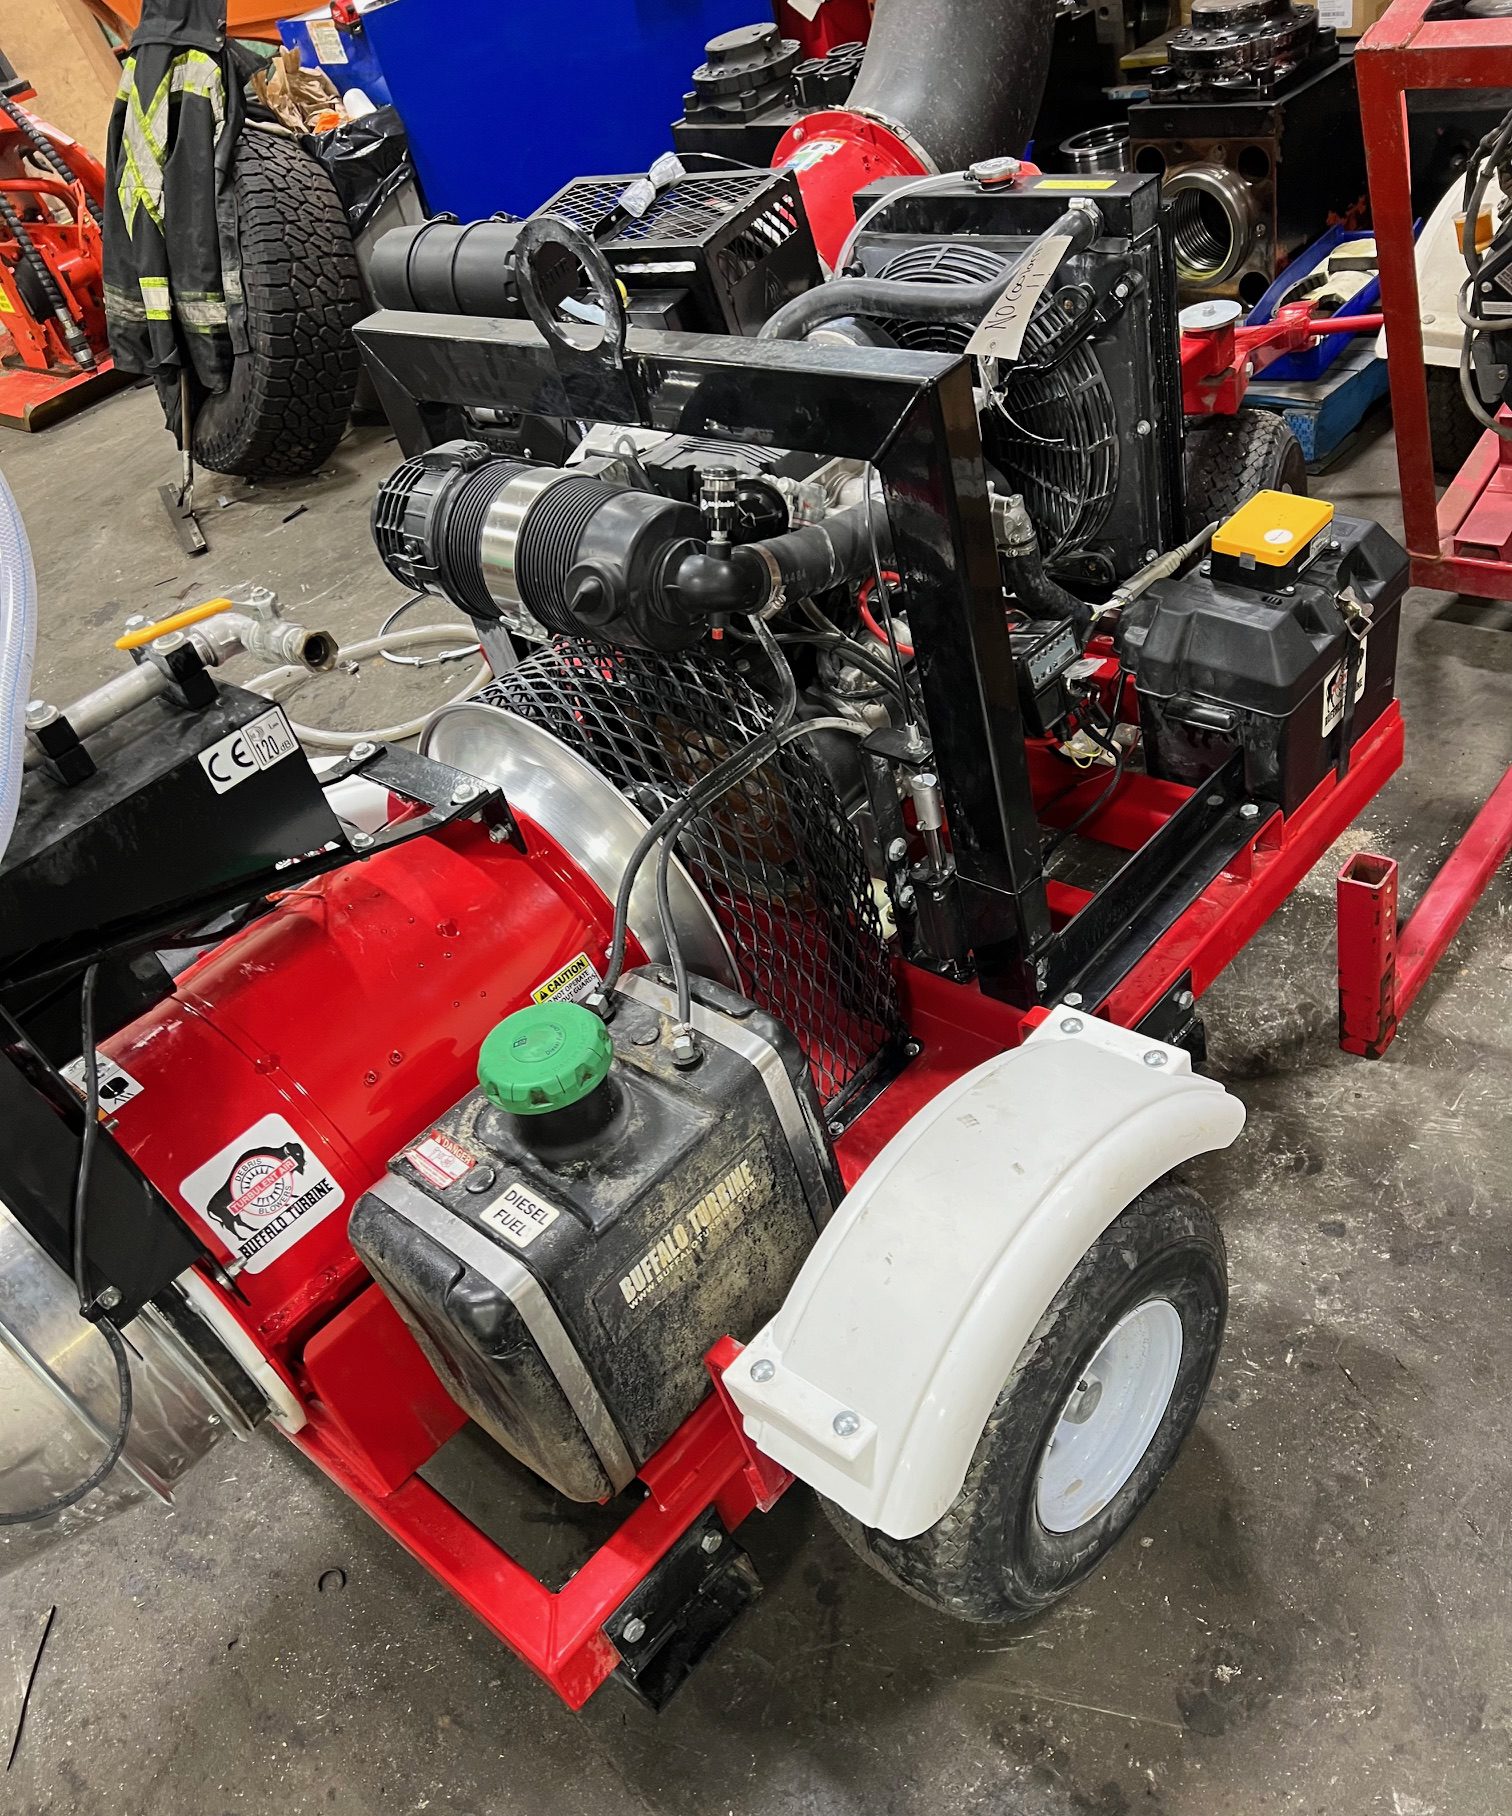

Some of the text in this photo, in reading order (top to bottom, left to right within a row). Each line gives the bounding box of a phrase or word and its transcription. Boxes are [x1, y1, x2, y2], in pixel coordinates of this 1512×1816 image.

[985, 305, 1017, 330] NO
[208, 737, 254, 782] CE
[256, 735, 291, 763] 120 dB
[547, 959, 586, 993] CAUTION
[553, 989, 566, 1001] NOT
[564, 970, 590, 992] OPERATE
[573, 973, 597, 994] GUARDS
[442, 1138, 473, 1165] DANGER
[235, 1158, 262, 1182] DEBRIS
[231, 1160, 294, 1212] TURBULENT AIR
[258, 1185, 292, 1215] BLOWERS
[240, 1179, 333, 1259] BUFFALO TURBINE
[493, 1208, 527, 1237] FUEL
[504, 1189, 549, 1226] DIESEL
[618, 1158, 754, 1304] BUFFALO TURBINE
